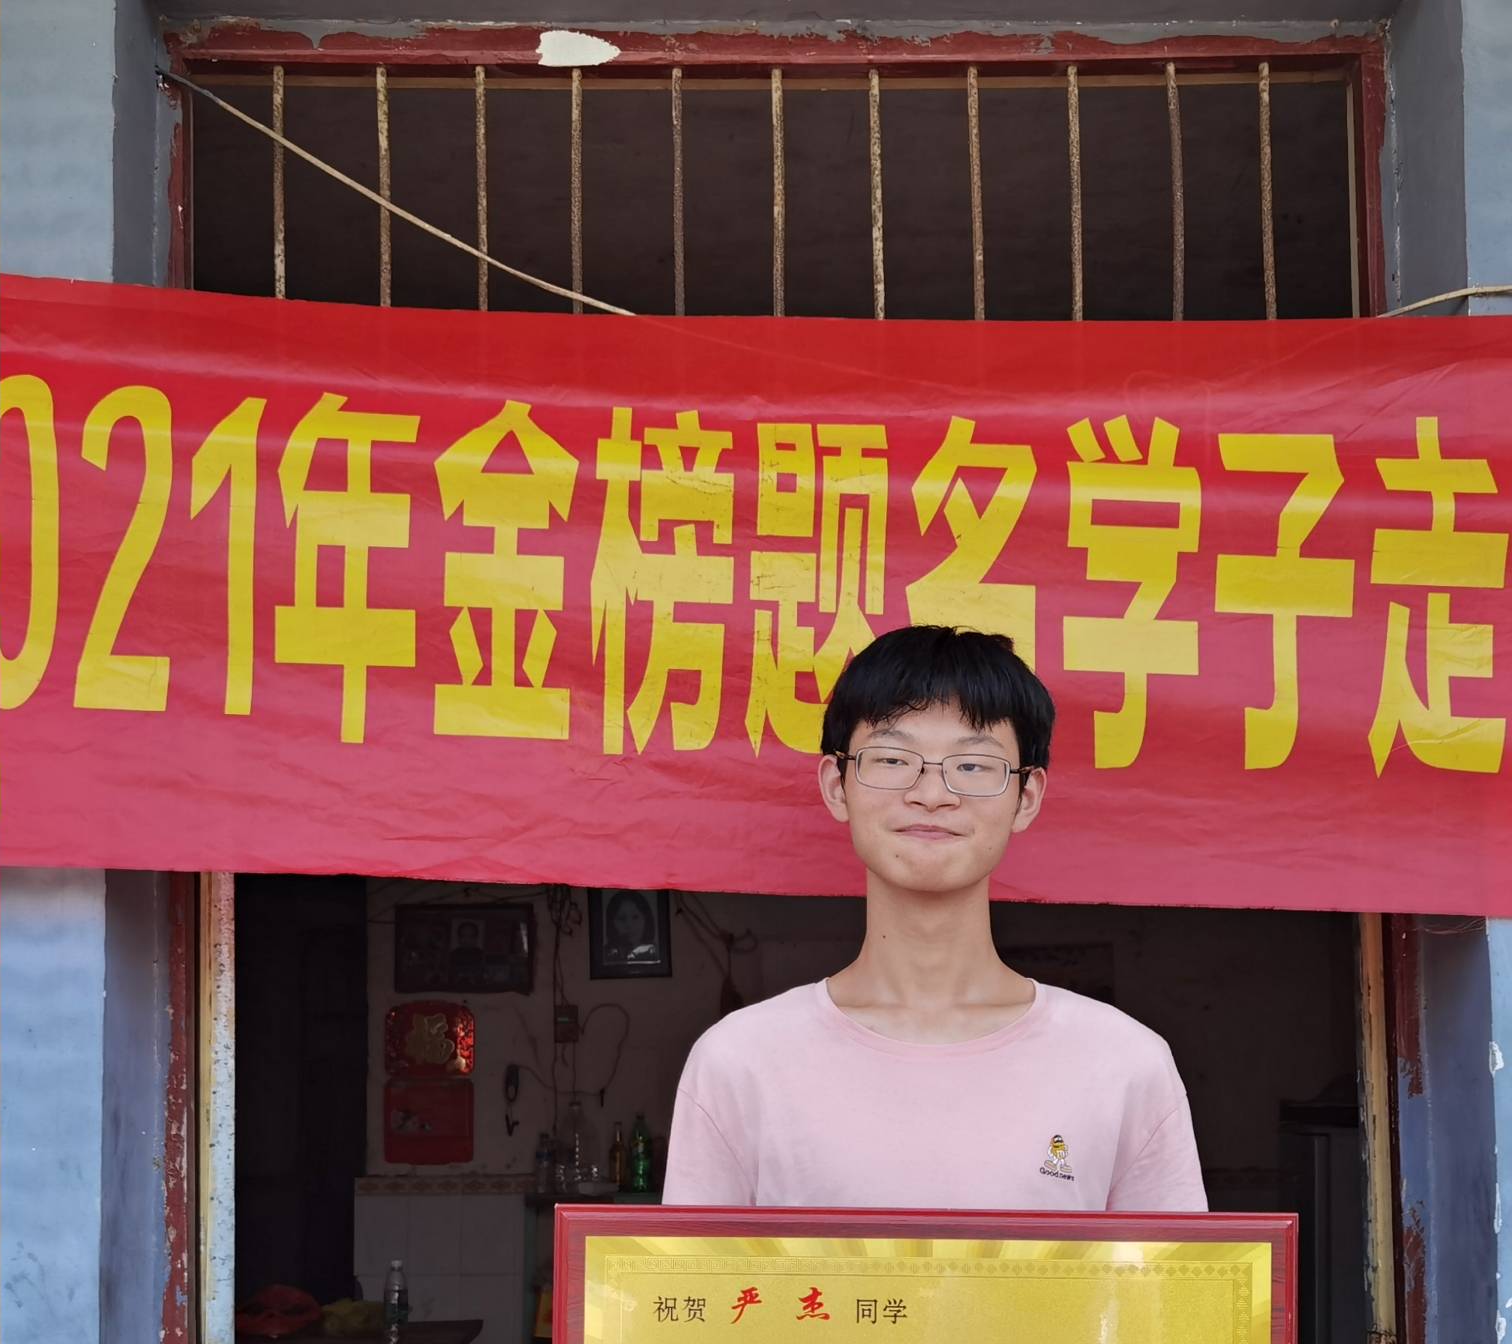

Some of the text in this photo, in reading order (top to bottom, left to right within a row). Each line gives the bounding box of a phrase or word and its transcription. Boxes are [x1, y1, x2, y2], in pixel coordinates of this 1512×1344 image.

[653, 1286, 908, 1324] 祝贺 严杰 同学
